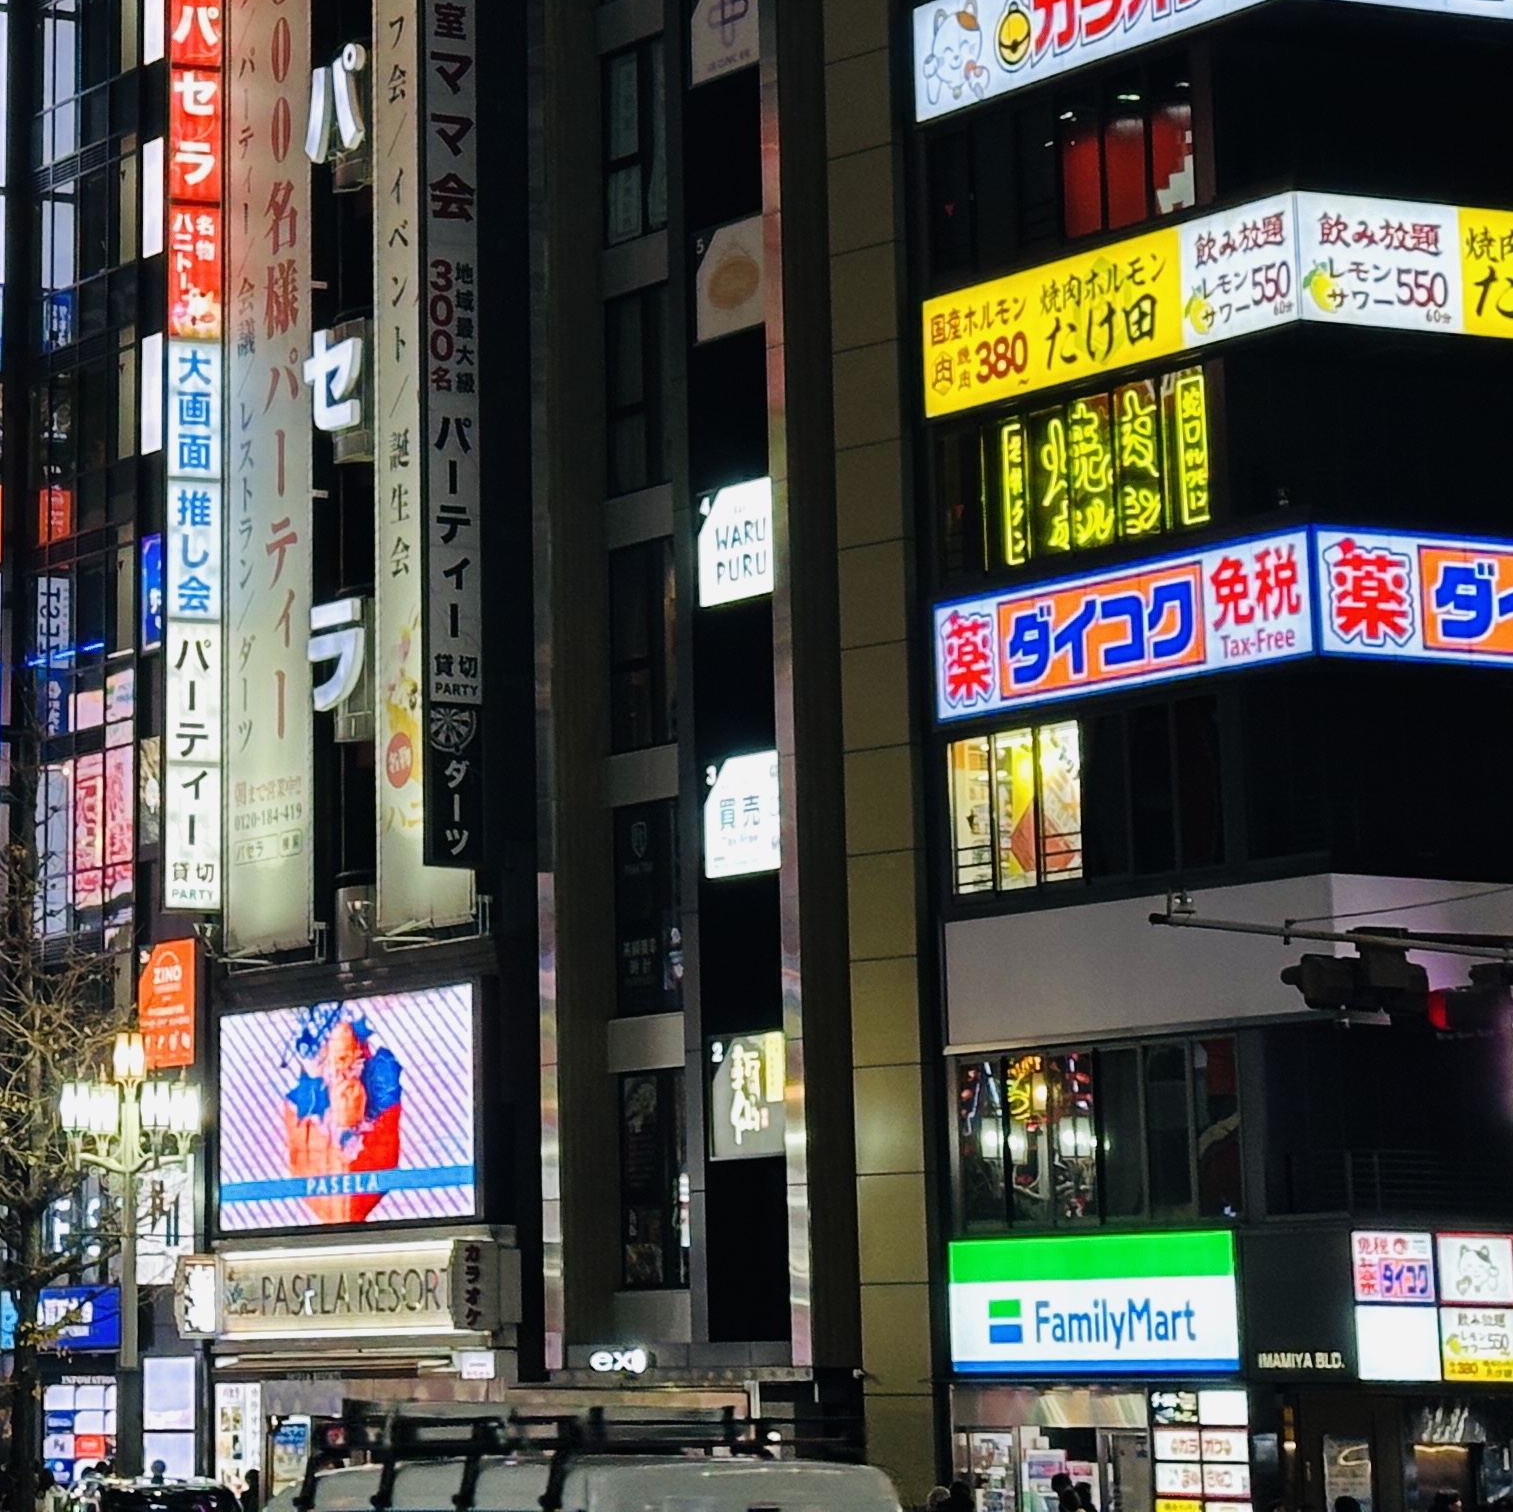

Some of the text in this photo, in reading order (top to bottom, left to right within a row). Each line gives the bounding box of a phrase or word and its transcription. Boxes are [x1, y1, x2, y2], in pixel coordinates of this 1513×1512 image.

[172, 5, 220, 186] パセラ
[1194, 211, 1286, 264] 飲み放題
[1319, 212, 1441, 258] 飲み放題
[1038, 252, 1168, 318] 焼肉ホルモン
[1203, 260, 1293, 306] レモン 550
[1326, 287, 1395, 313] サワー
[1328, 260, 1448, 308] レモン 550
[929, 294, 1029, 346] 国産ホルモン
[1045, 293, 1158, 370] たけ田
[1202, 301, 1251, 330] サワー
[976, 330, 1029, 384] 380
[434, 416, 473, 639] パーティー
[715, 515, 767, 553] WARU
[715, 548, 768, 586] PURU
[1209, 543, 1302, 630] 免税
[1328, 540, 1414, 648] 薬
[433, 653, 479, 678] 貸切
[941, 579, 1197, 706] 薬 ダイコク
[1220, 627, 1296, 660] Tax-Free
[434, 681, 480, 697] PARTY
[174, 639, 213, 846] パーティー
[444, 759, 470, 856] ダーツ
[171, 888, 214, 901] PARTY
[172, 862, 215, 883] 貸切
[305, 1172, 380, 1196] PASELA
[260, 1271, 350, 1318] PASELA
[464, 1245, 483, 1331] カラオケ
[1380, 1261, 1432, 1295] ダイコク
[1035, 1298, 1197, 1350] FamilyMart
[1257, 1351, 1346, 1370] IMAMIYA BLD.
